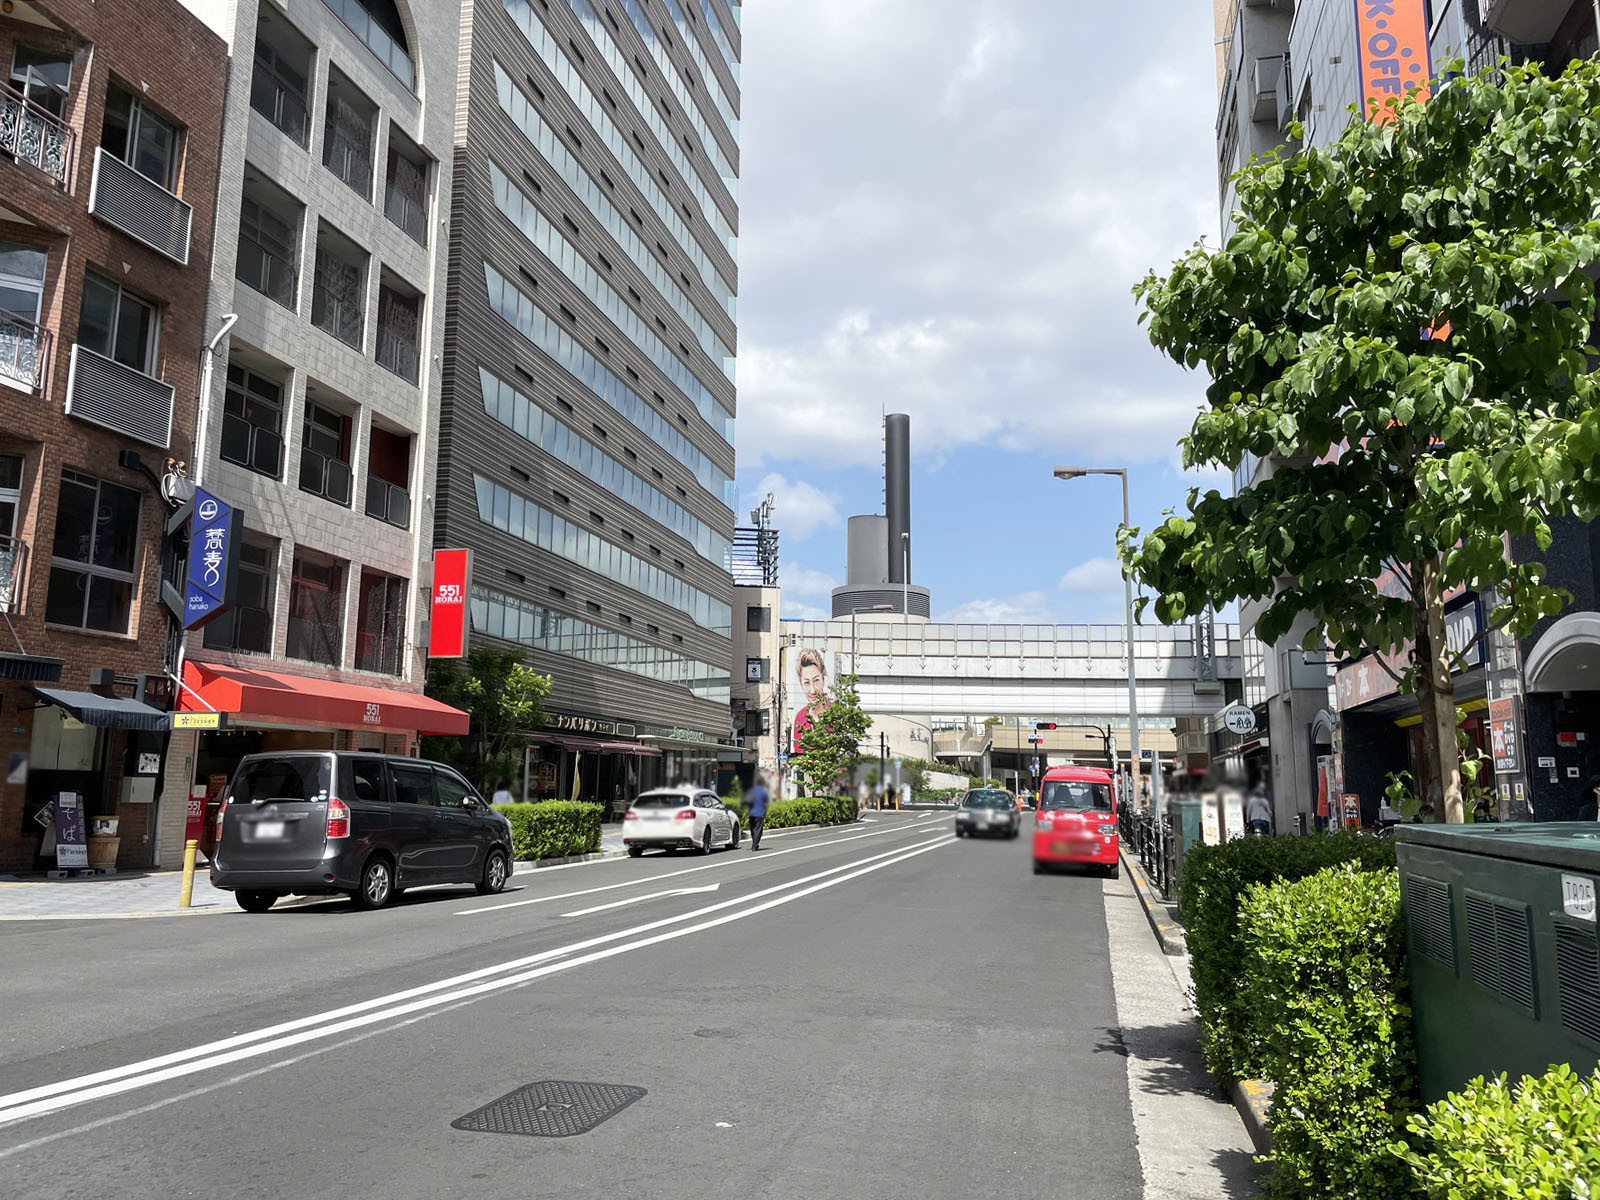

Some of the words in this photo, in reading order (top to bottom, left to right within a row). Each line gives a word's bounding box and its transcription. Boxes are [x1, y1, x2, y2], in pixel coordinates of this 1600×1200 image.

[203, 528, 225, 587] 蕎麦
[439, 585, 460, 597] 551
[435, 596, 463, 604] HORAI
[188, 603, 209, 611] hanako
[1446, 616, 1474, 660] DVD
[366, 703, 380, 715] 551
[187, 801, 201, 811] 551
[61, 808, 76, 841] そば
